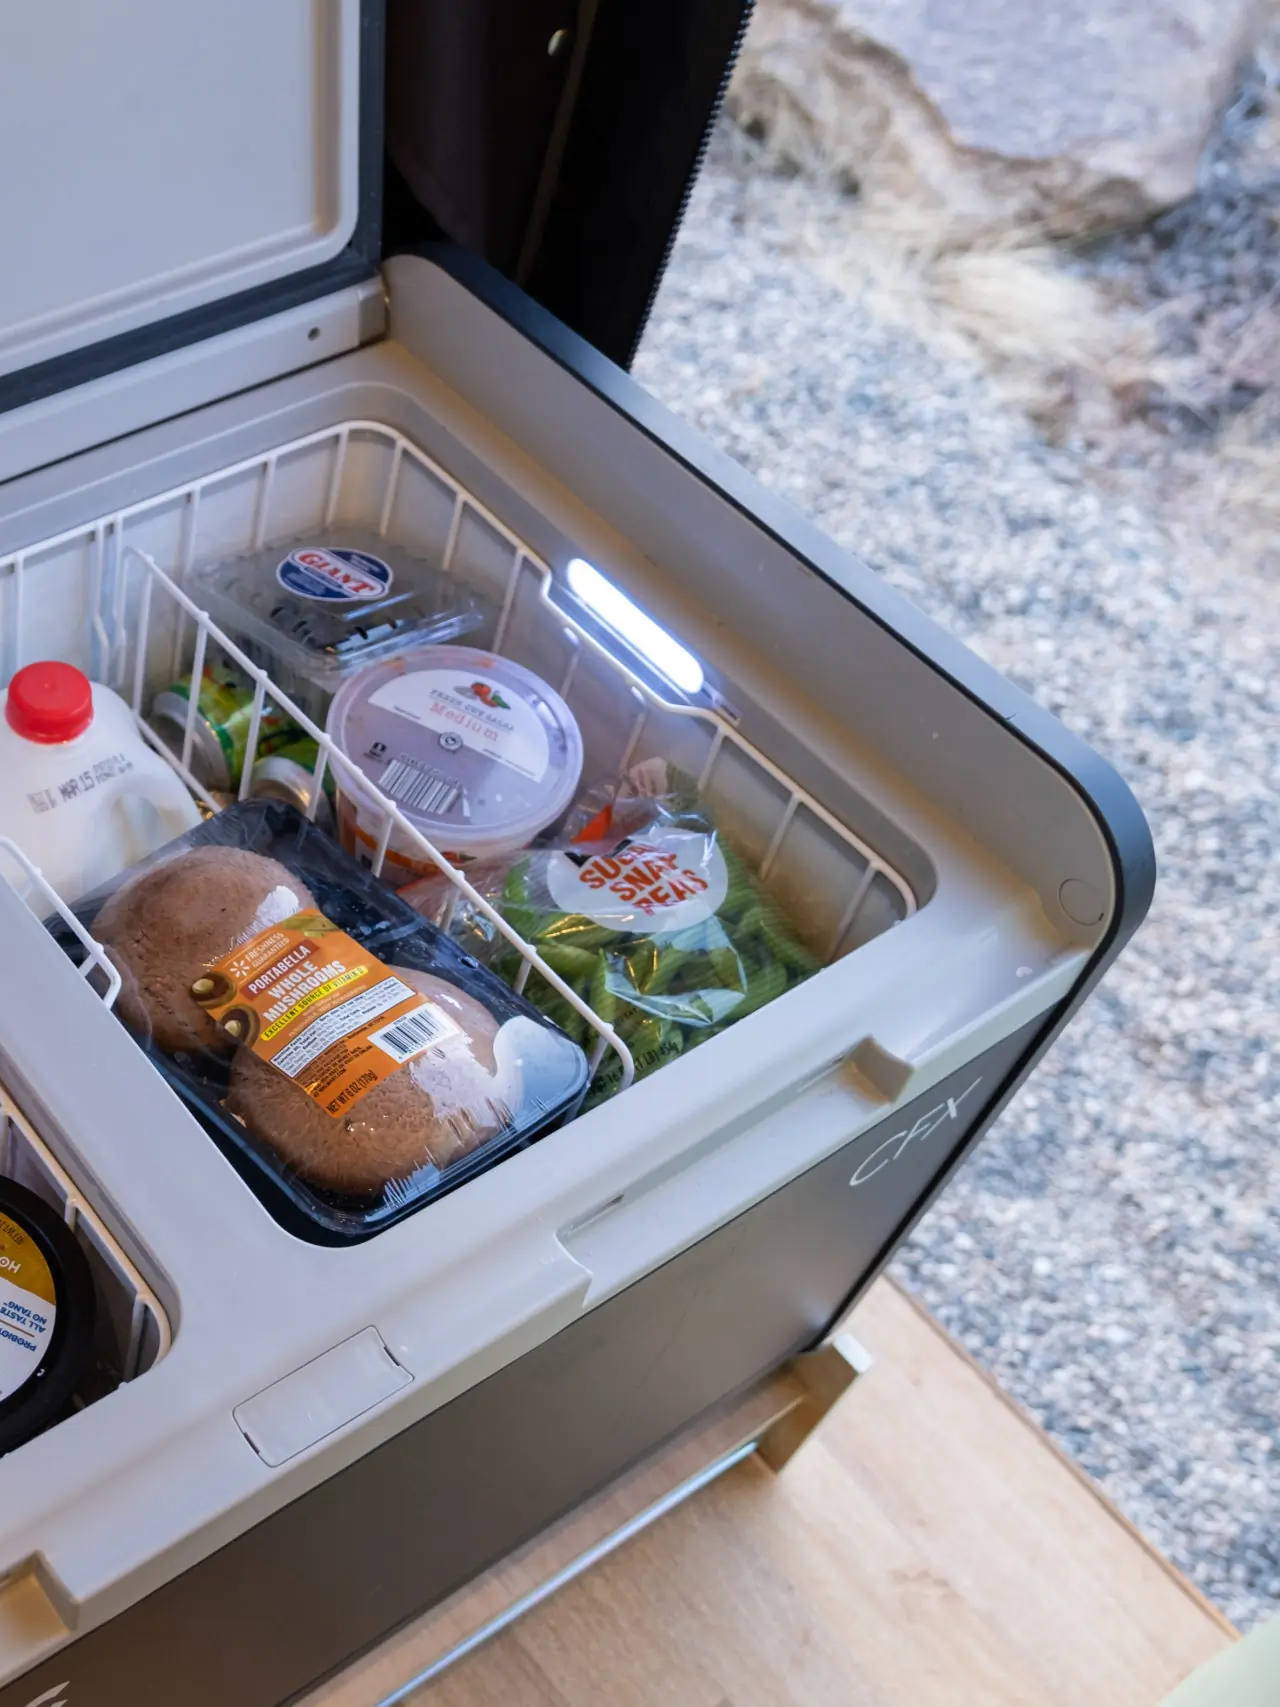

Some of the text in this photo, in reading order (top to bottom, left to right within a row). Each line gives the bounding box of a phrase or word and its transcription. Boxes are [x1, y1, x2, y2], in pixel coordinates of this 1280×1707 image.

[299, 553, 375, 593] GIANT
[429, 701, 499, 742] Medium
[579, 844, 658, 889] SUG
[609, 853, 677, 902] SNAP
[632, 868, 708, 916] PEAS
[245, 932, 285, 962] FRESHNESS
[247, 945, 311, 994] PORTABELLA
[268, 960, 318, 999] WHOLE
[262, 960, 346, 1023] MUSHROOMS
[264, 1008, 299, 1039] EXCELLENT
[299, 989, 324, 1010] SOURCE
[324, 984, 332, 993] OF
[333, 971, 358, 988] VITAMIN
[326, 1099, 340, 1115] NET
[338, 1091, 350, 1106] WT
[352, 1079, 362, 1092] OZ
[849, 1076, 983, 1186] CFX
[0, 1307, 46, 1333] ALL TASTE
[33, 1314, 47, 1325] NO
